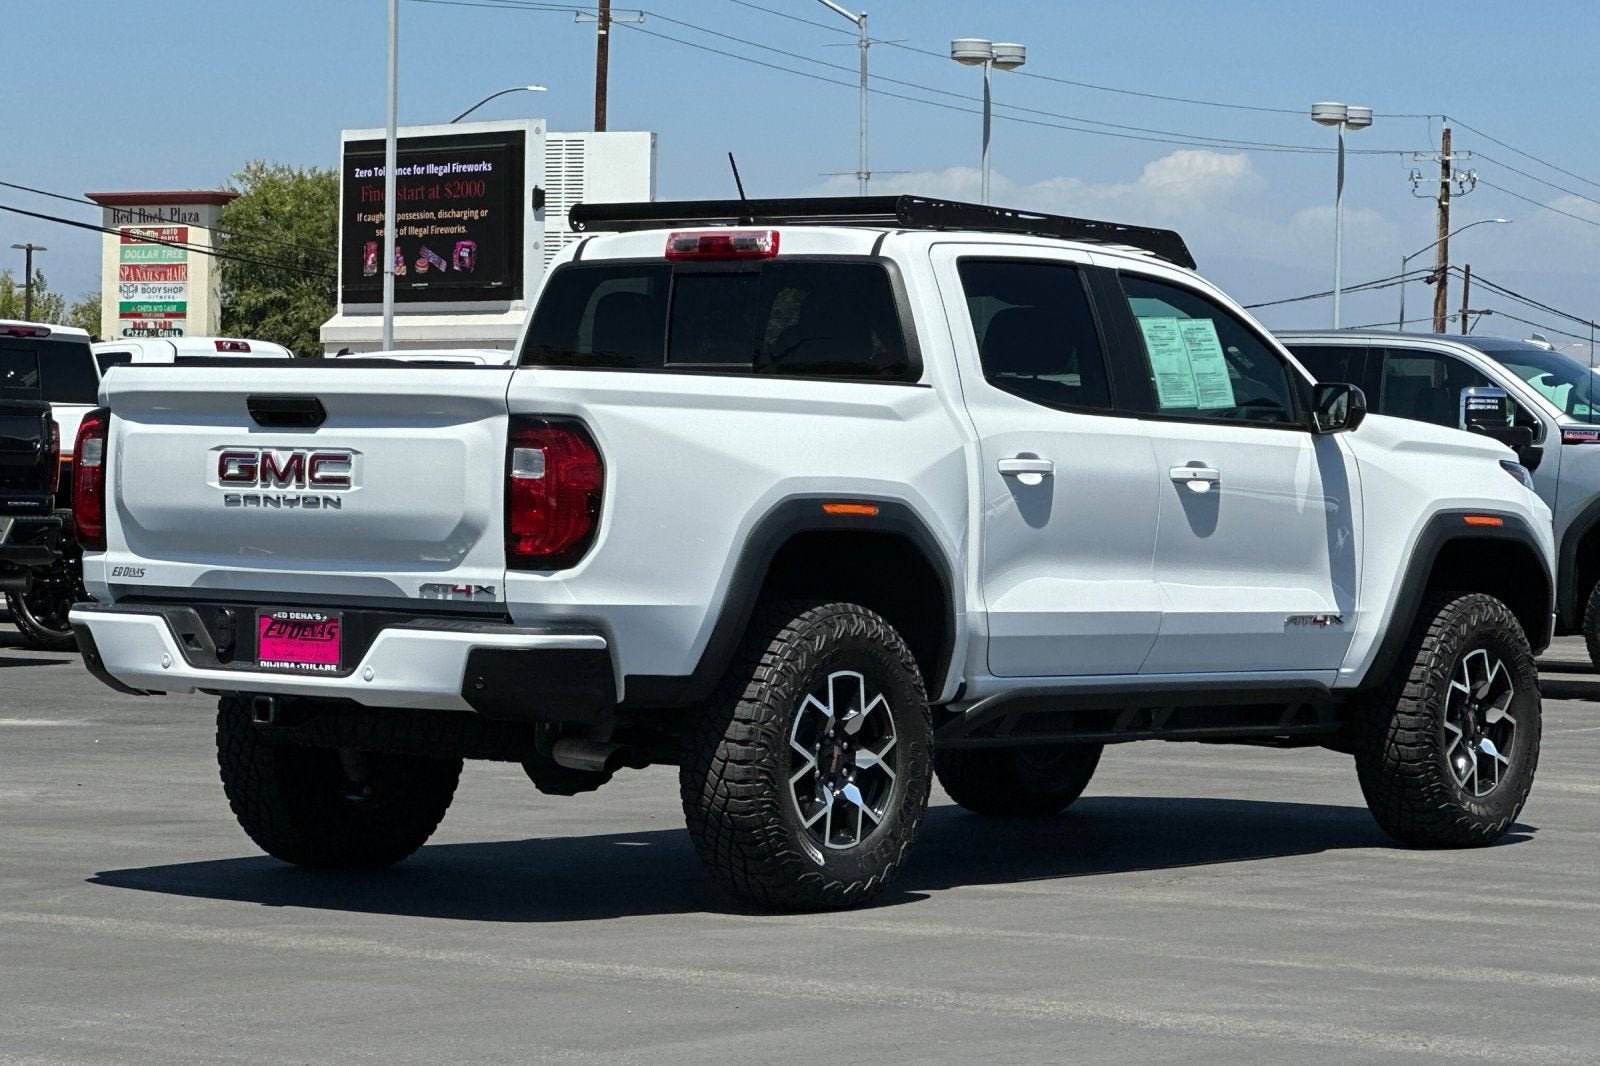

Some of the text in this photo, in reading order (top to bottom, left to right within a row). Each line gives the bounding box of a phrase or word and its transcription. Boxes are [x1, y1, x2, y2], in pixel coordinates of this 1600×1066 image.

[355, 161, 492, 178] Zero Tolnce for Illegal Fireworks
[428, 184, 440, 199] at
[444, 180, 486, 199] $2000
[112, 207, 200, 224] Red Rock Plaza
[357, 209, 489, 224] If caugh possession, discharging or
[399, 226, 408, 236] of
[408, 225, 430, 238] Illegal
[430, 224, 468, 236] Fireworks.
[124, 249, 184, 259] DOLLAR TREE
[120, 265, 134, 281] SPA
[166, 264, 187, 281] HAIR
[141, 286, 184, 294] BODY SHOP
[218, 450, 353, 490] GMC
[223, 493, 342, 510] CANYON
[277, 611, 322, 620] ED DENA'S
